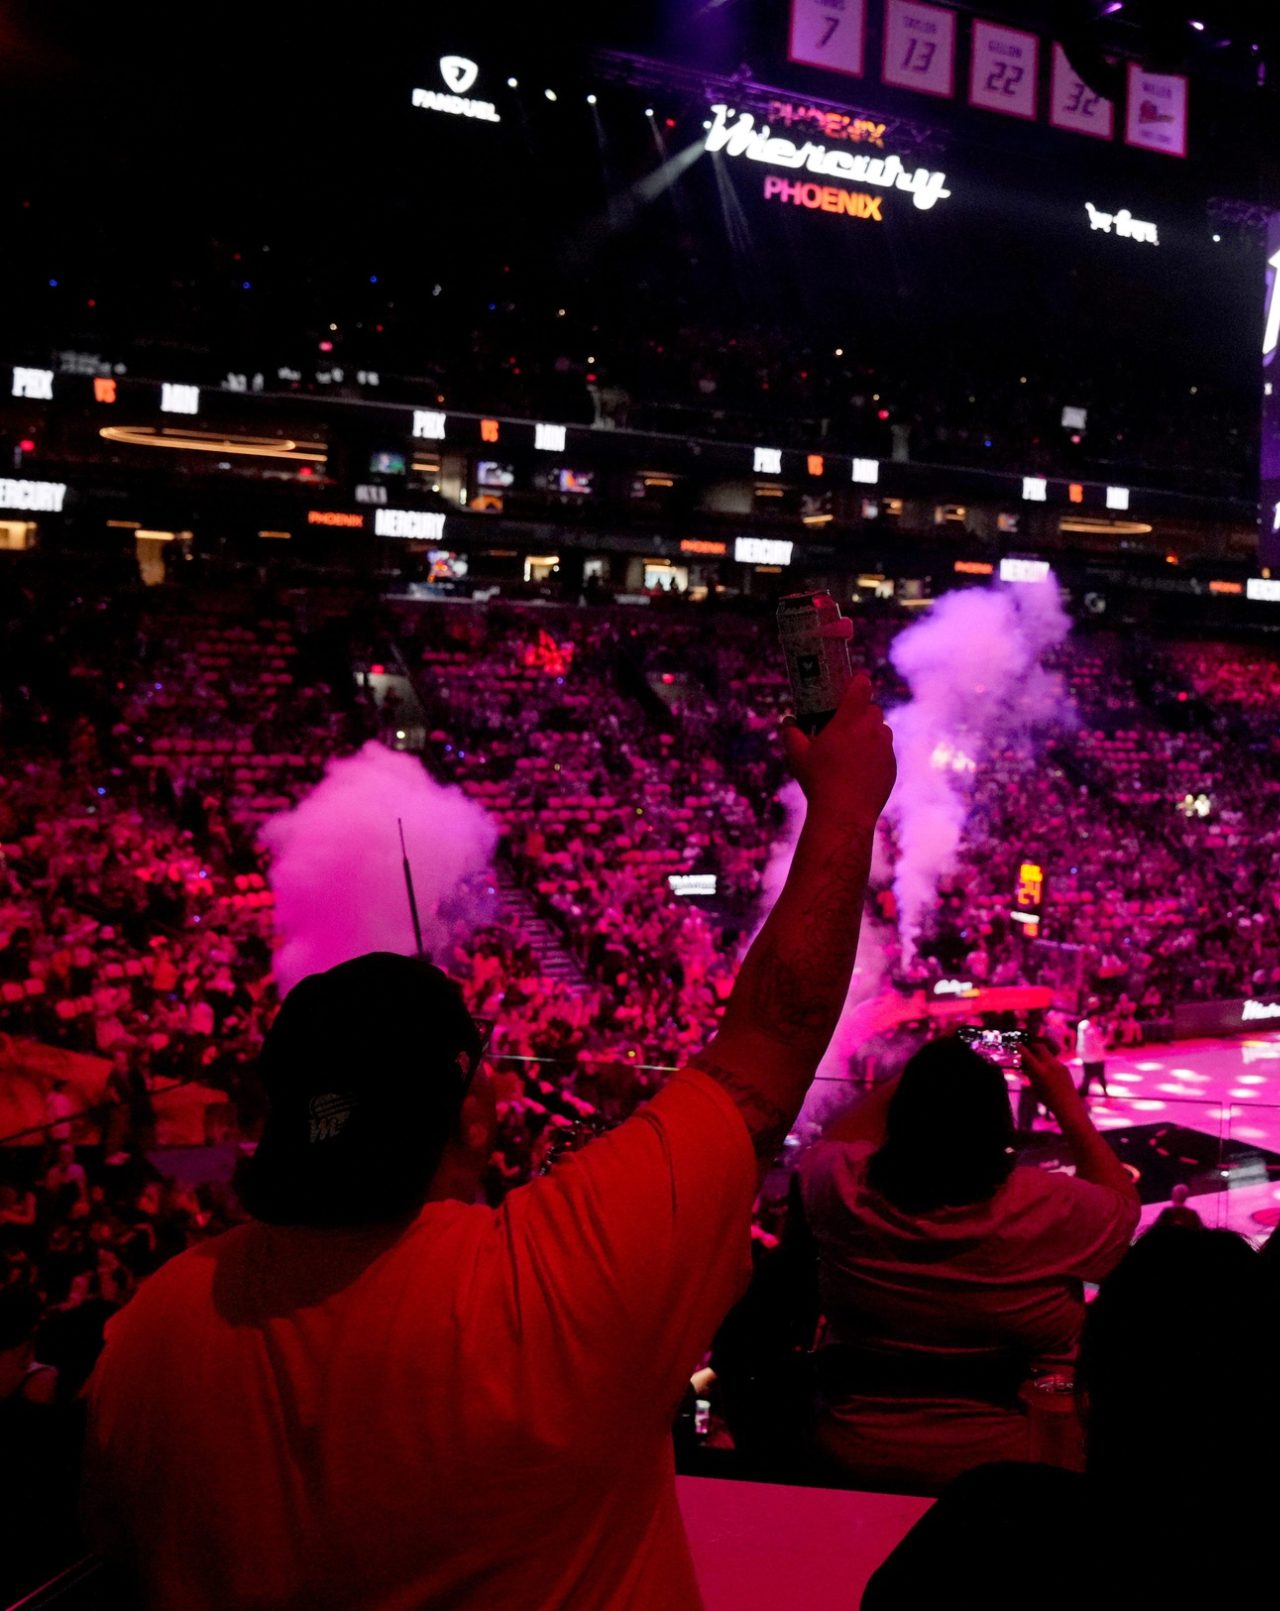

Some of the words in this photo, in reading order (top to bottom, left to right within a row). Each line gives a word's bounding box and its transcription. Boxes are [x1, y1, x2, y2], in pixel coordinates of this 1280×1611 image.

[815, 16, 840, 49] 7
[903, 38, 937, 72] 13
[986, 61, 1024, 95] 22
[411, 87, 501, 122] FANDUEL
[703, 104, 951, 211] Mercury
[764, 175, 883, 222] PHOENIX
[308, 512, 363, 527] PHOENIX
[375, 509, 446, 540] MERCURY
